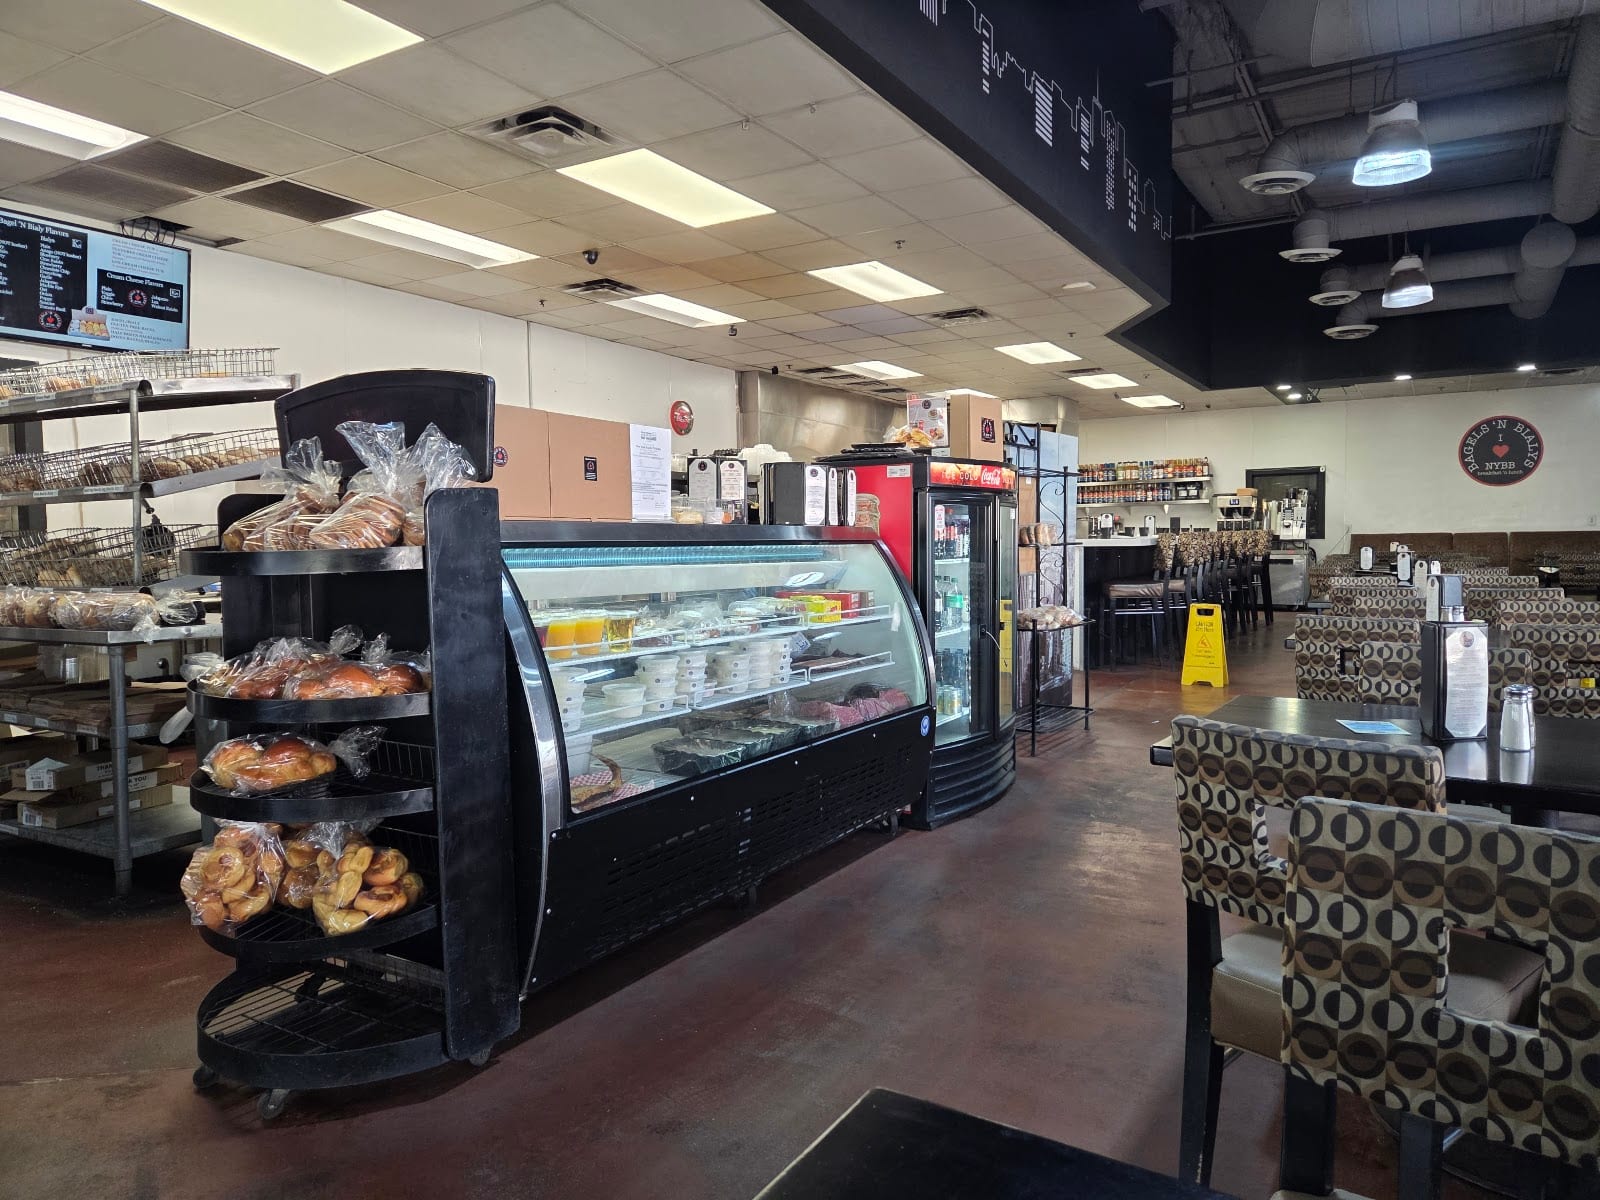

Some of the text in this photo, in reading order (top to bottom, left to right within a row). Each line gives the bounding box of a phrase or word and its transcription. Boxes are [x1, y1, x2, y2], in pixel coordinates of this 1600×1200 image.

[28, 222, 44, 233] Bialy
[45, 227, 70, 237] Flavors
[106, 272, 125, 281] Cream
[125, 275, 145, 284] Cheese
[1498, 434, 1503, 442] I
[1463, 423, 1490, 473] BAGELS
[1513, 423, 1539, 468] BIALYS
[1485, 461, 1516, 470] NYBB
[941, 470, 956, 480] ICE
[960, 471, 978, 481] COLD
